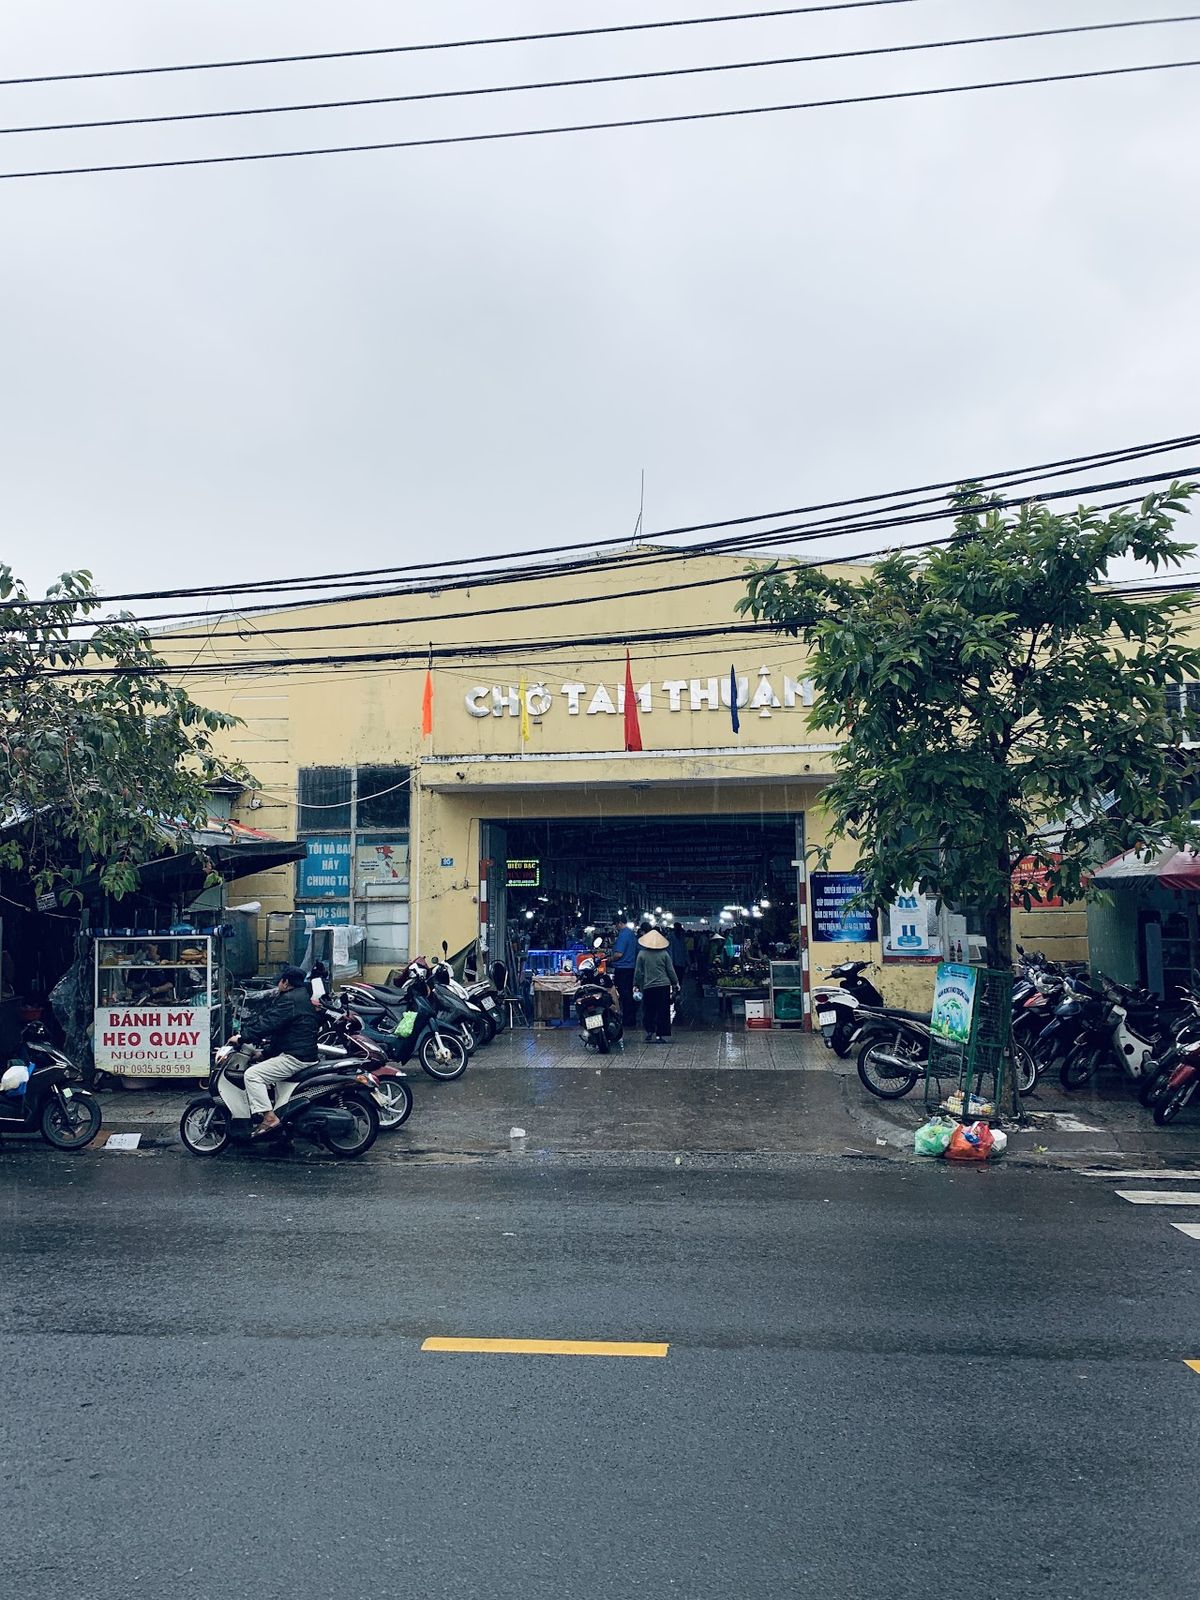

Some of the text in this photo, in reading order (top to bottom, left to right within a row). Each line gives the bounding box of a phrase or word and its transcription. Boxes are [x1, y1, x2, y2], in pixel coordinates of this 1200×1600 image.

[464, 664, 815, 724] CHỢ TAM THUẬN
[323, 842, 335, 855] VÀ
[322, 858, 340, 871] HÃY
[337, 876, 349, 886] TA
[109, 1009, 195, 1027] BÁNH MỲ
[103, 1032, 201, 1047] HEO QUAY
